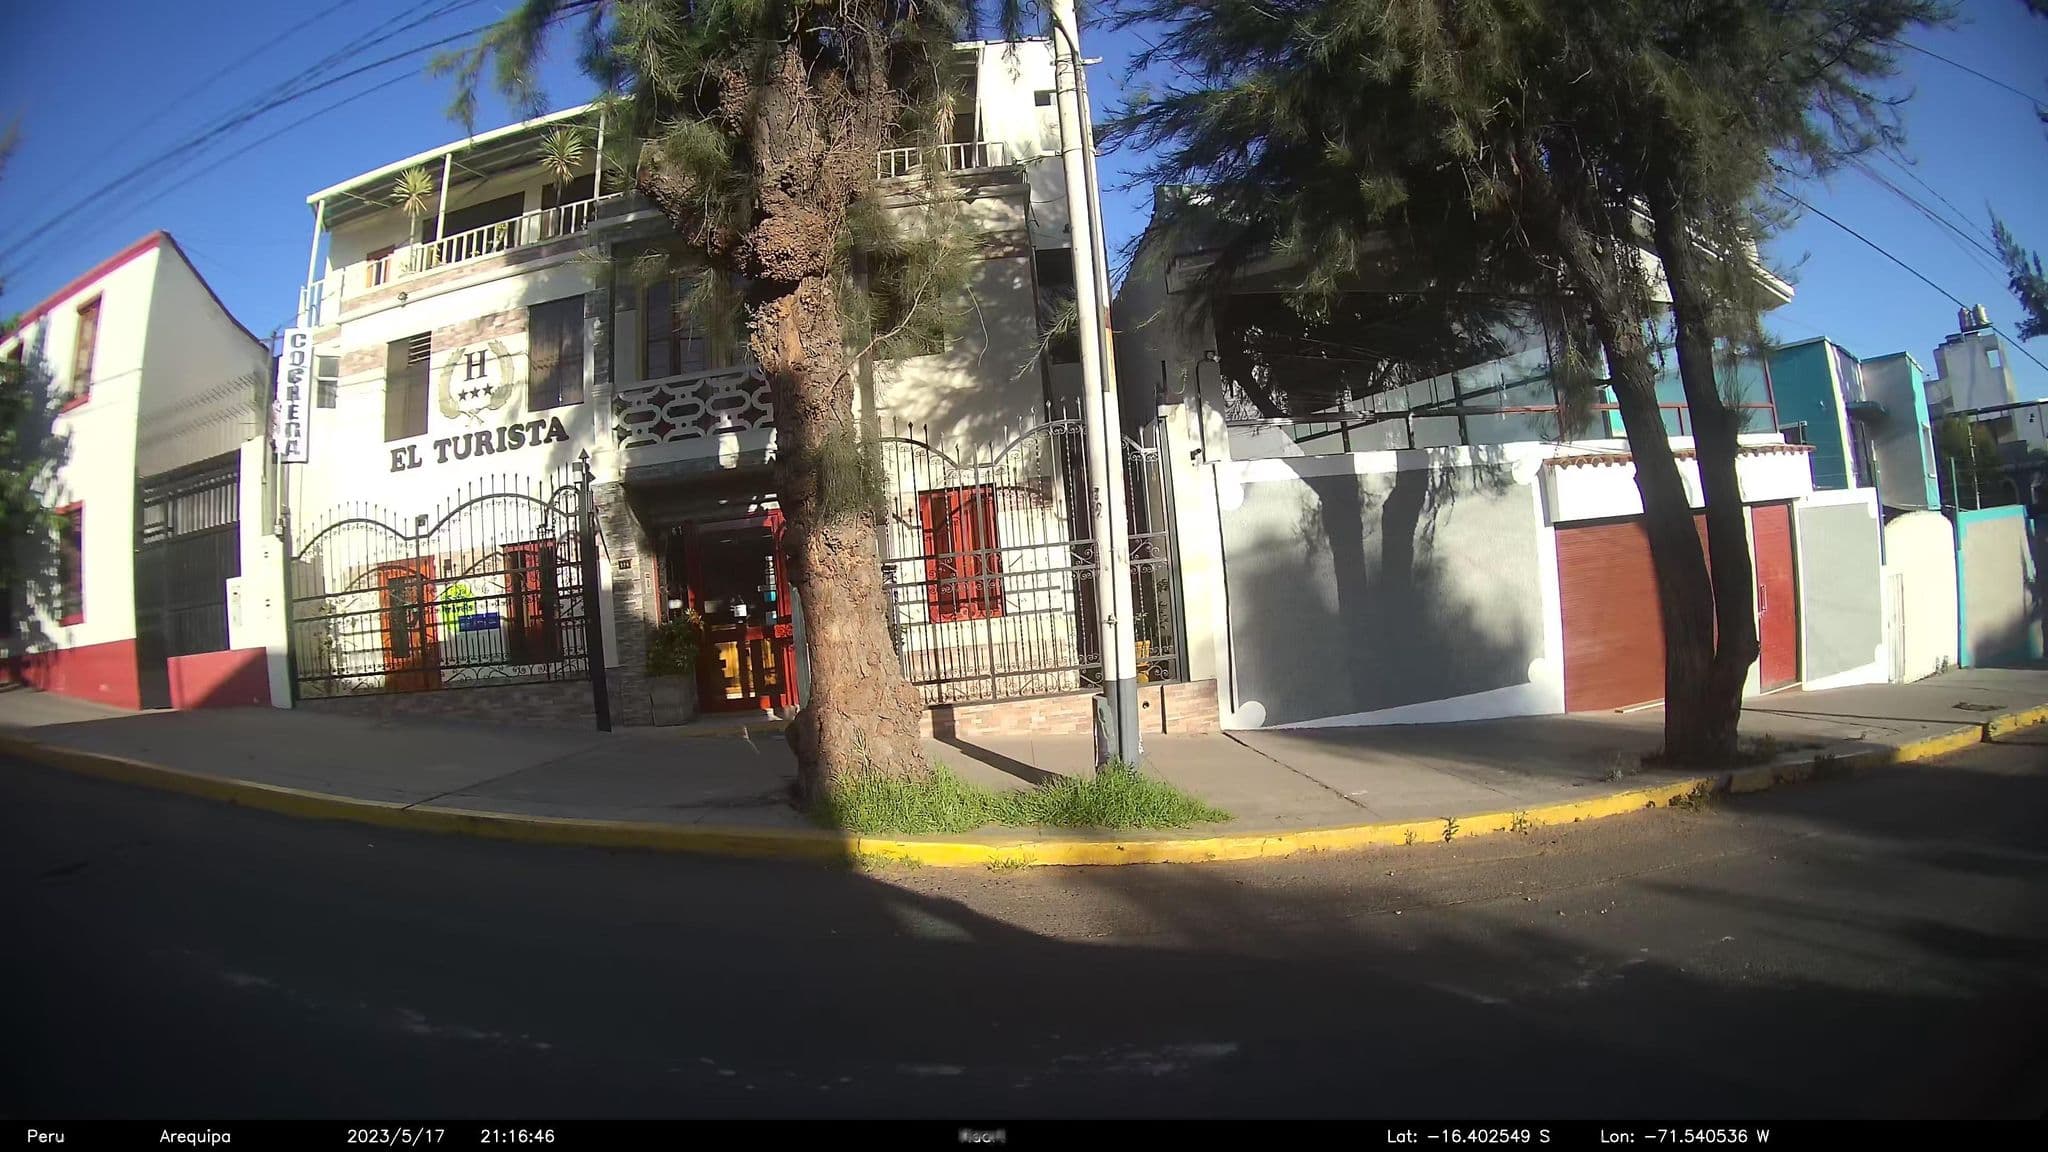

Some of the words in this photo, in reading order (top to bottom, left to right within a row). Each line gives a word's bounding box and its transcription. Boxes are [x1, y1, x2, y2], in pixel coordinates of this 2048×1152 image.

[284, 332, 308, 456] COCHERA
[463, 349, 489, 382] H
[389, 443, 423, 473] EL
[433, 416, 570, 464] TURISTA
